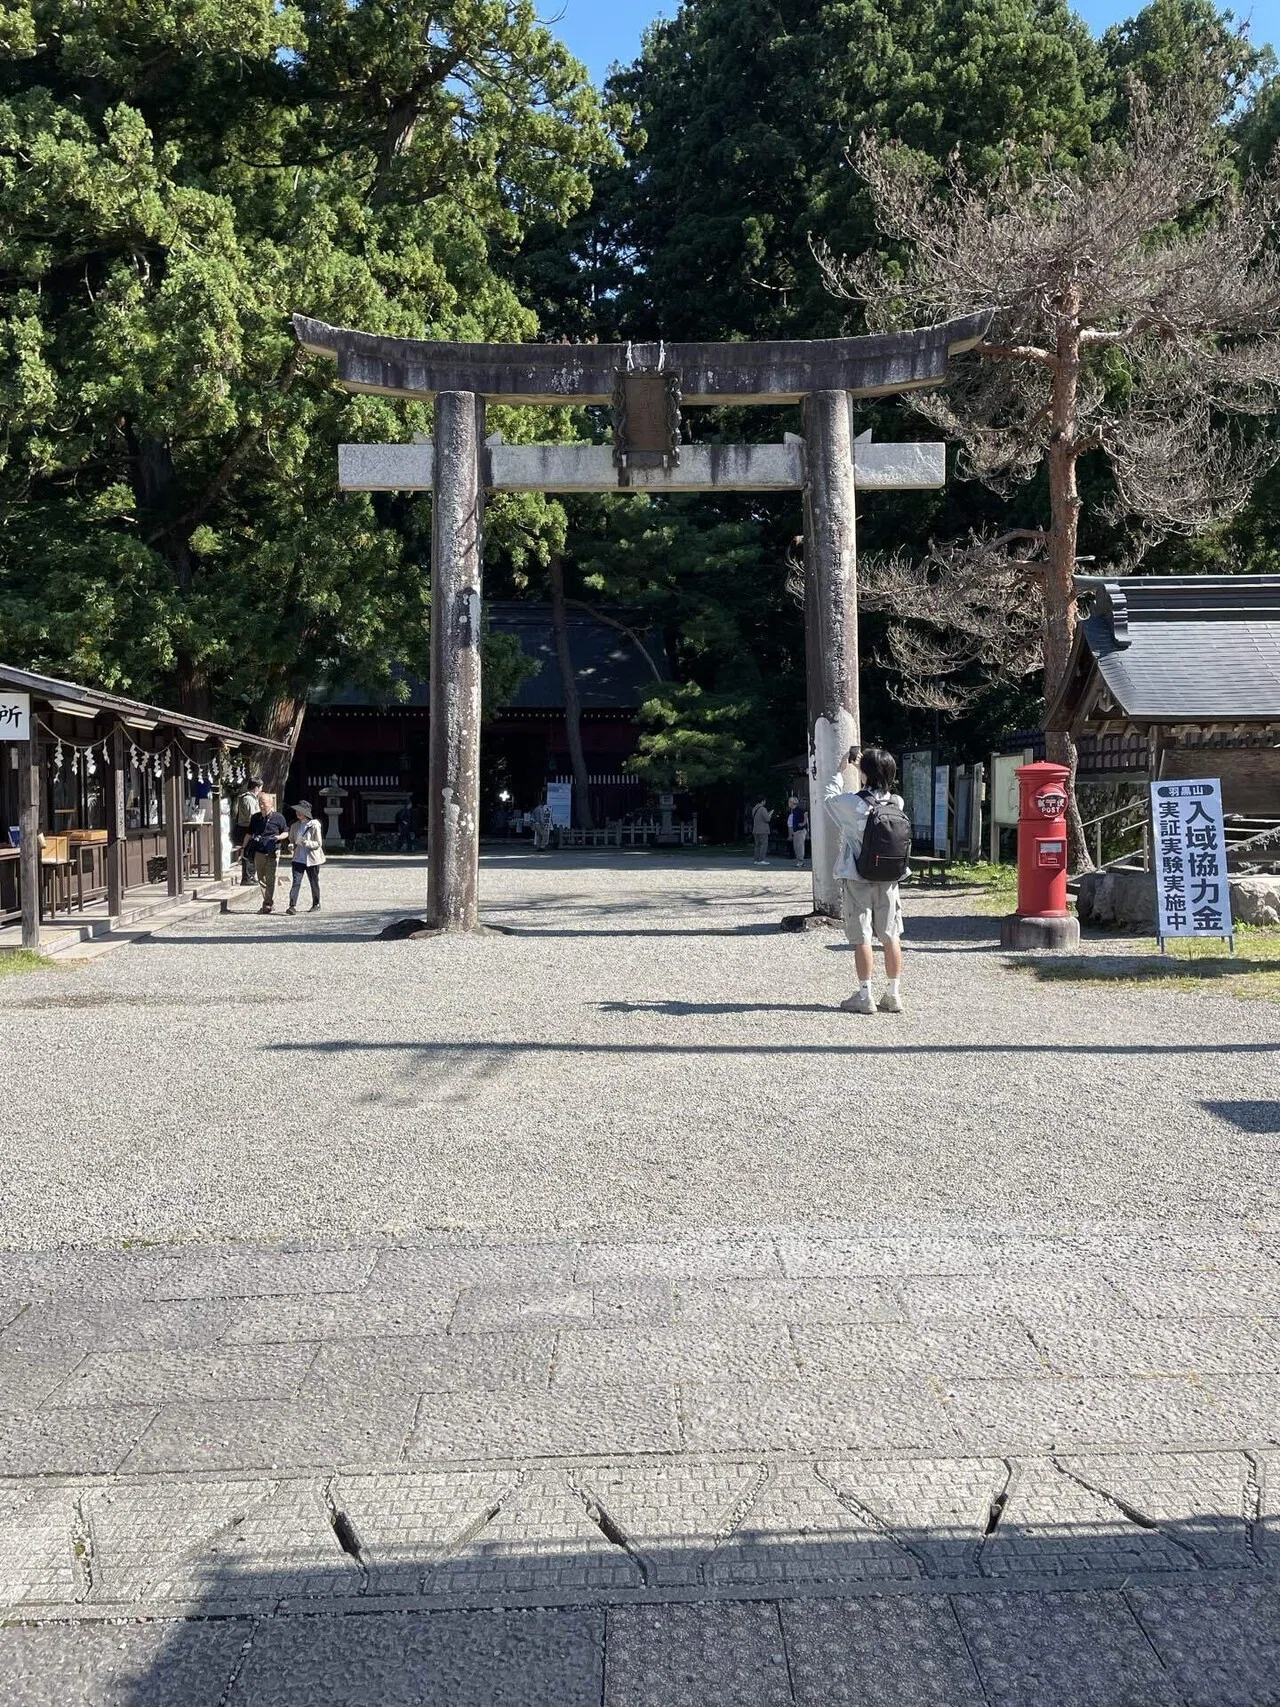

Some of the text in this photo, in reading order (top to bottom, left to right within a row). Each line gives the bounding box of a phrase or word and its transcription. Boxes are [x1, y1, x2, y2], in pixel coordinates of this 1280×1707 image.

[0, 704, 23, 729] 所
[1168, 786, 1204, 797] 羽黒山
[1158, 801, 1187, 931] 実証実験実施中
[1185, 801, 1223, 931] 入域協力金
